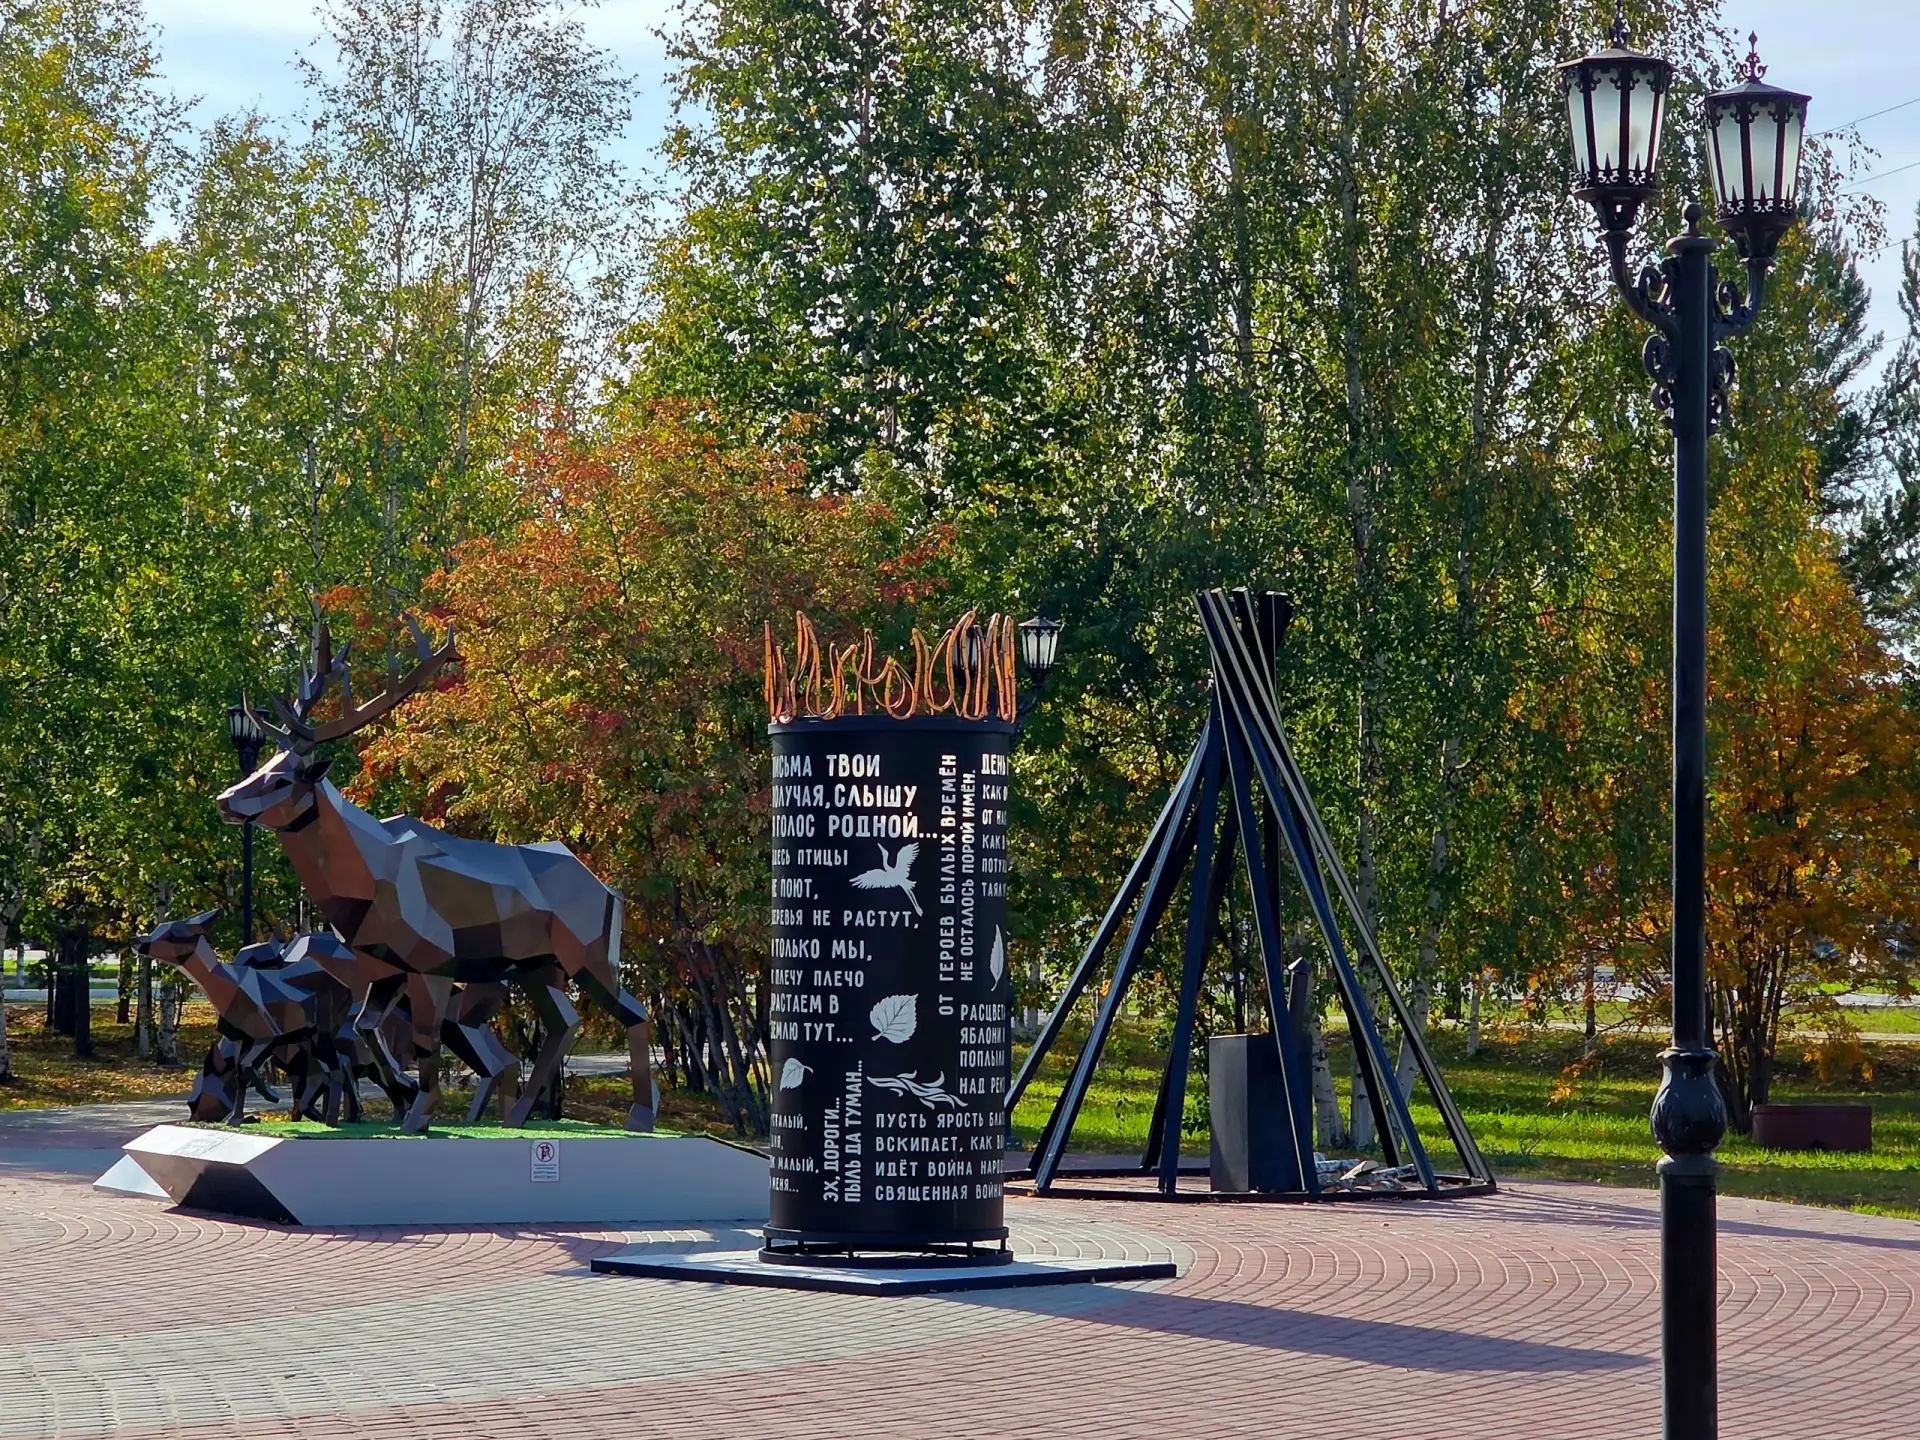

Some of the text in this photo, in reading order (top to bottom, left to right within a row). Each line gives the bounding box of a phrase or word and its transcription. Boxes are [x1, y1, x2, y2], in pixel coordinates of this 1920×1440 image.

[826, 754, 881, 777] ТВОИ
[834, 783, 917, 808] СЛЫШУ
[982, 784, 1002, 800] КАК
[828, 811, 938, 838] РОДНОЙ...
[982, 808, 993, 825] ОТ
[982, 834, 1001, 849] КАК
[797, 849, 848, 867] ПТИЦЫ
[960, 769, 976, 981] НЕ ОСТАЛОСЬ ПОРОЙ ИМЁН.
[780, 878, 819, 900] ПОЮТ,
[938, 754, 957, 1016] ОТ ГЕРОЕВ БЫЛЫХ ВРЕМЁН
[771, 908, 919, 929] ЕРЕВЬЯ НЕ РАСТУТ,
[775, 938, 820, 959] ТОЛЬКО
[831, 939, 873, 961] МЫ,
[813, 970, 865, 988] ПЛЕЧО
[771, 992, 840, 1014] РАСТАЕМ В
[770, 1021, 853, 1043] ЕМЛЮ ТУТ...
[959, 1077, 986, 1094] НАД
[771, 1113, 808, 1131] СТАЛЫЙ,
[875, 1113, 927, 1129] ПУСТЬ
[937, 1112, 984, 1128] ЯРОСТЬ
[844, 1060, 863, 1203] ПЫЛЬ ДА ТУМАН...
[823, 1097, 841, 1202] ЭХ, ДОРОГИ...
[875, 1136, 963, 1152] ВСКИПАЕТ,
[970, 1135, 992, 1151] КАК
[778, 1156, 819, 1174] МАЛЫЙ,
[875, 1159, 918, 1177] ИДЁТ
[928, 1159, 973, 1177] ВОЙНА
[875, 1185, 968, 1202] СВЯЩЕННАЯ
